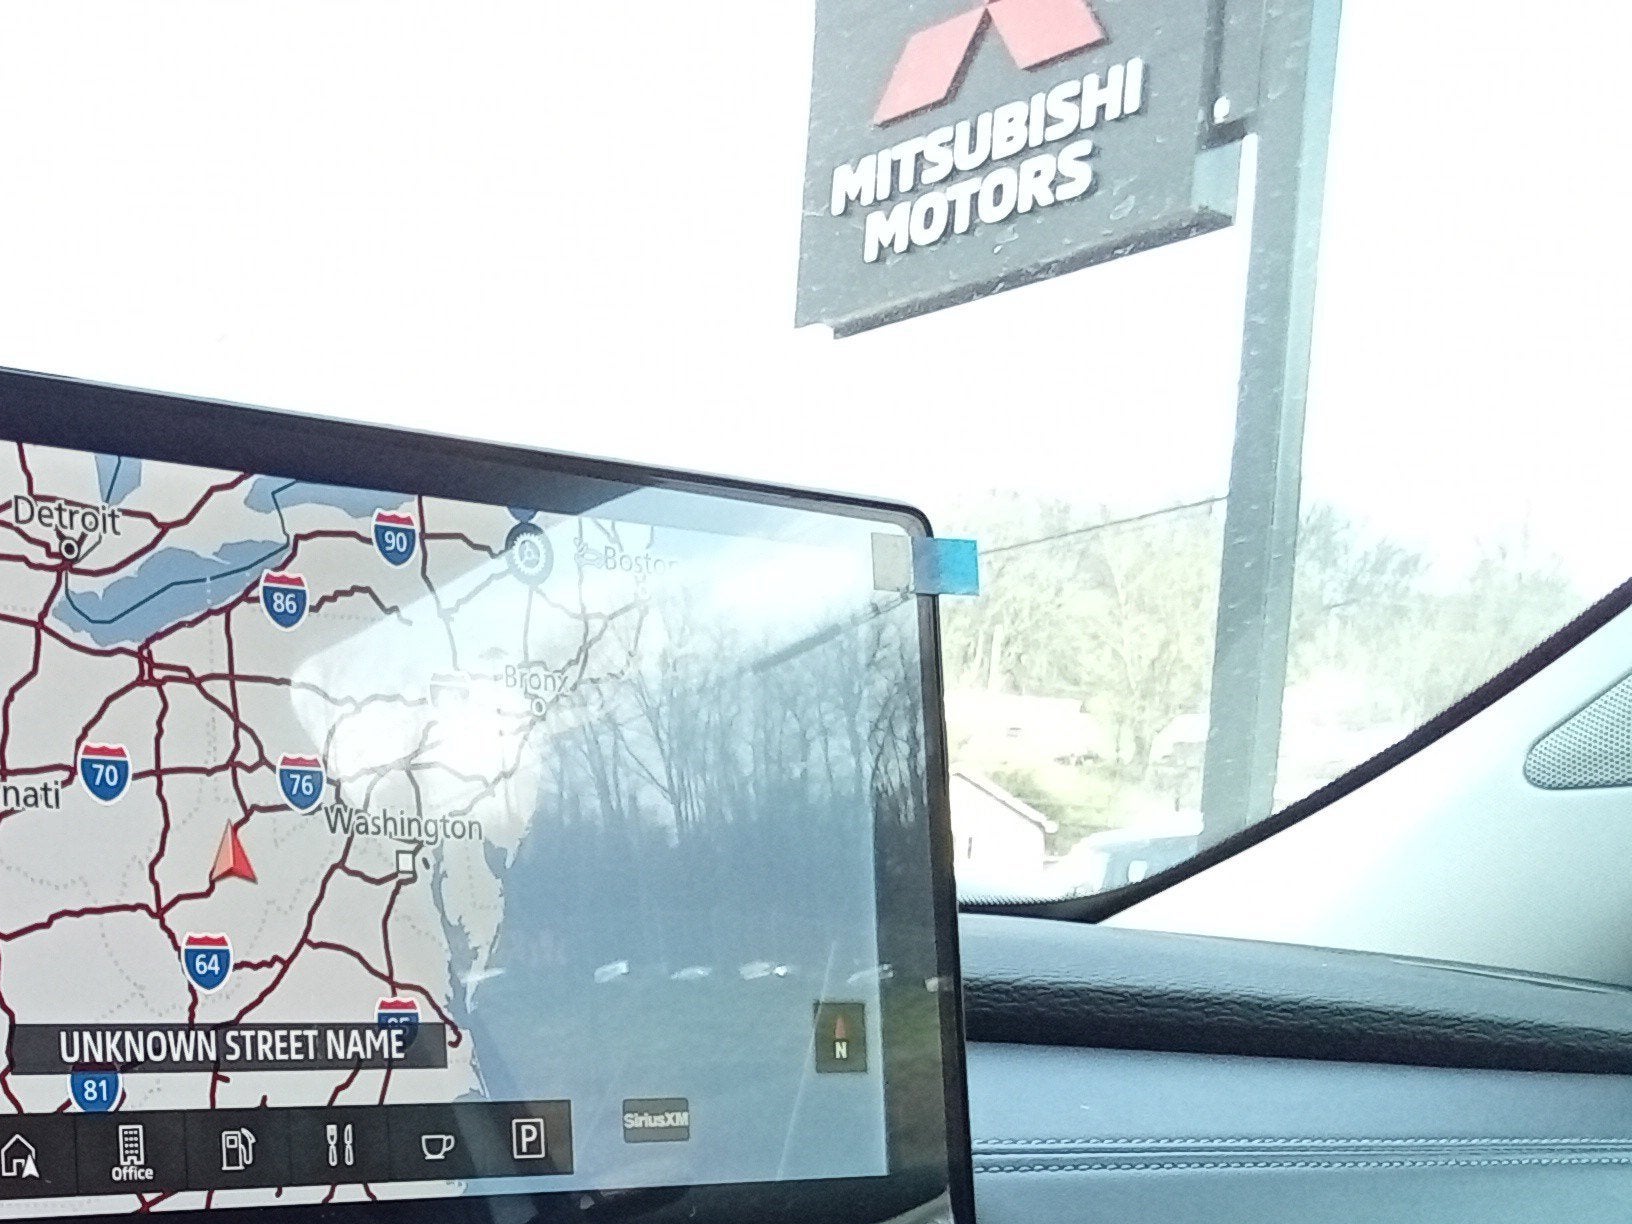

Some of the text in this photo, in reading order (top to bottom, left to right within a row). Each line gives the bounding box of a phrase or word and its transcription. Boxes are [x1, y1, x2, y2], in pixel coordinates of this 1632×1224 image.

[830, 57, 1145, 216] MITSUBISHI
[863, 139, 1093, 263] MOTORS
[14, 497, 121, 537] Detroit
[384, 531, 407, 553] 90
[605, 546, 678, 576] Bosto
[272, 591, 298, 614] 86
[505, 664, 568, 692] Bronx
[92, 765, 119, 787] 70
[289, 774, 314, 797] 76
[325, 806, 483, 842] Washington
[196, 954, 220, 975] 64
[60, 1029, 405, 1063] UNKNOWN STREET NAME
[835, 1041, 847, 1059] N
[83, 1080, 106, 1101] 81
[624, 1112, 688, 1129] SiriusXM
[522, 1126, 537, 1153] P
[111, 1165, 153, 1181] Office
